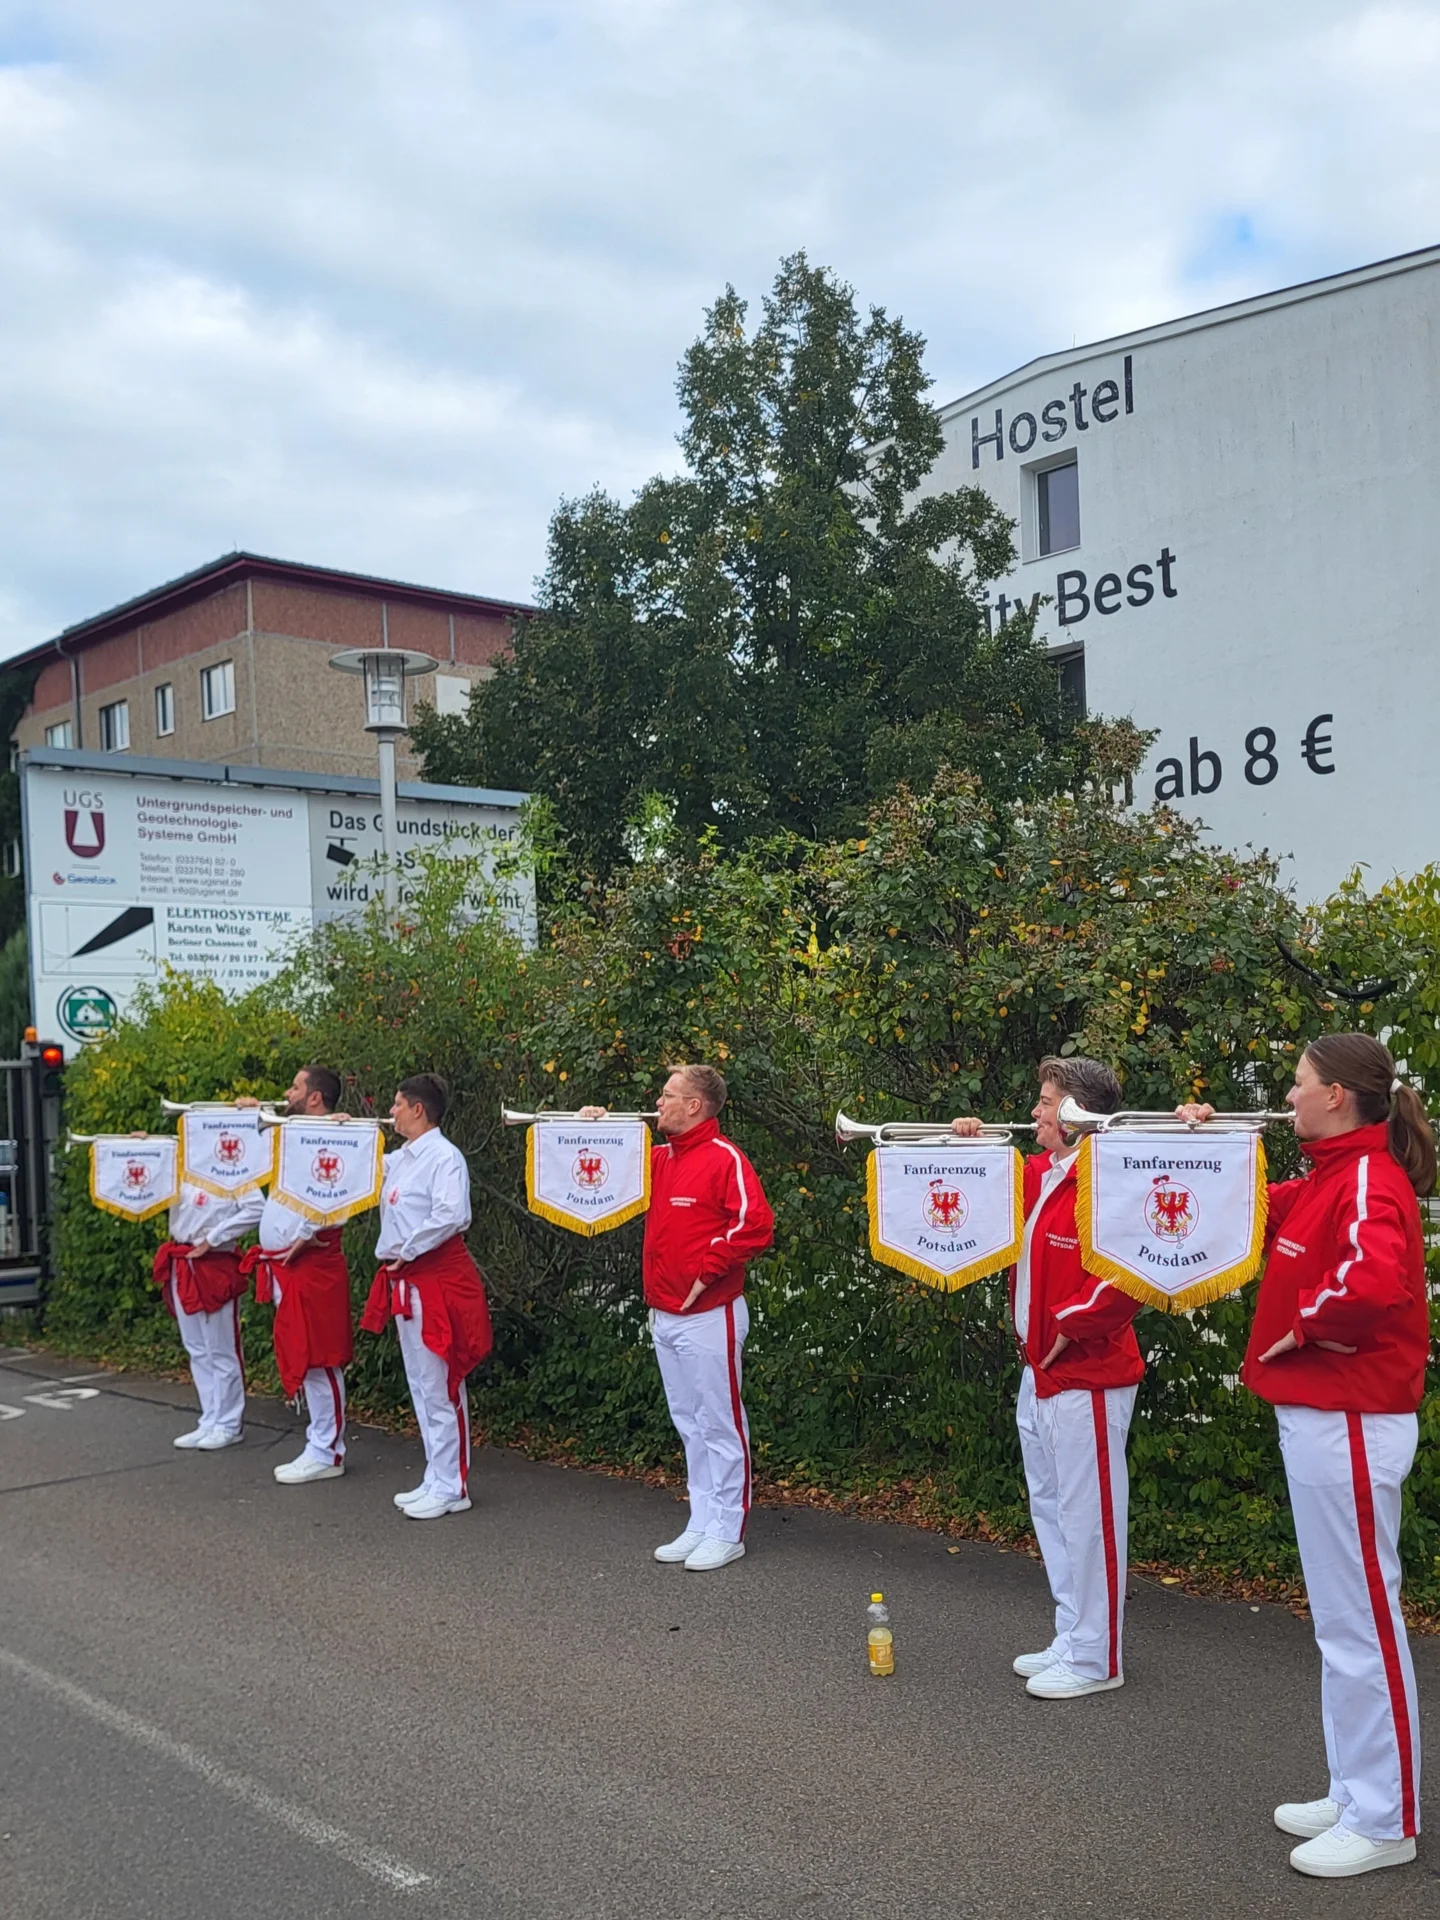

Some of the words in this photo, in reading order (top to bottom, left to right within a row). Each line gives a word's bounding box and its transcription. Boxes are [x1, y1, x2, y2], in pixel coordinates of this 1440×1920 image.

[970, 355, 1135, 469] Hostel
[1056, 548, 1178, 627] Best
[1154, 737, 1223, 800] ab
[1243, 726, 1279, 786] 8
[1300, 713, 1336, 775] €
[64, 789, 104, 809] UGS
[136, 796, 267, 816] Untergrundspeicher-
[270, 808, 293, 819] und
[137, 811, 243, 831] Geotechnologie-
[330, 810, 367, 831] Das
[487, 824, 515, 842] der
[137, 827, 193, 841] Systeme
[197, 831, 237, 844] GmbH
[327, 883, 368, 902] wird
[167, 907, 293, 922] ELEKTROSYSTEME
[168, 922, 212, 934] Karsten
[301, 1137, 359, 1147] Fanfarenzug
[557, 1135, 624, 1146] Fanfarenzug
[903, 1164, 987, 1176] Fanfarenzug
[1123, 1156, 1223, 1173] Fanfarenzug
[306, 1186, 348, 1198] Potsdam
[566, 1192, 615, 1206] Potsdam
[917, 1235, 978, 1252] Potsdam
[1137, 1244, 1209, 1267] Potsdam
